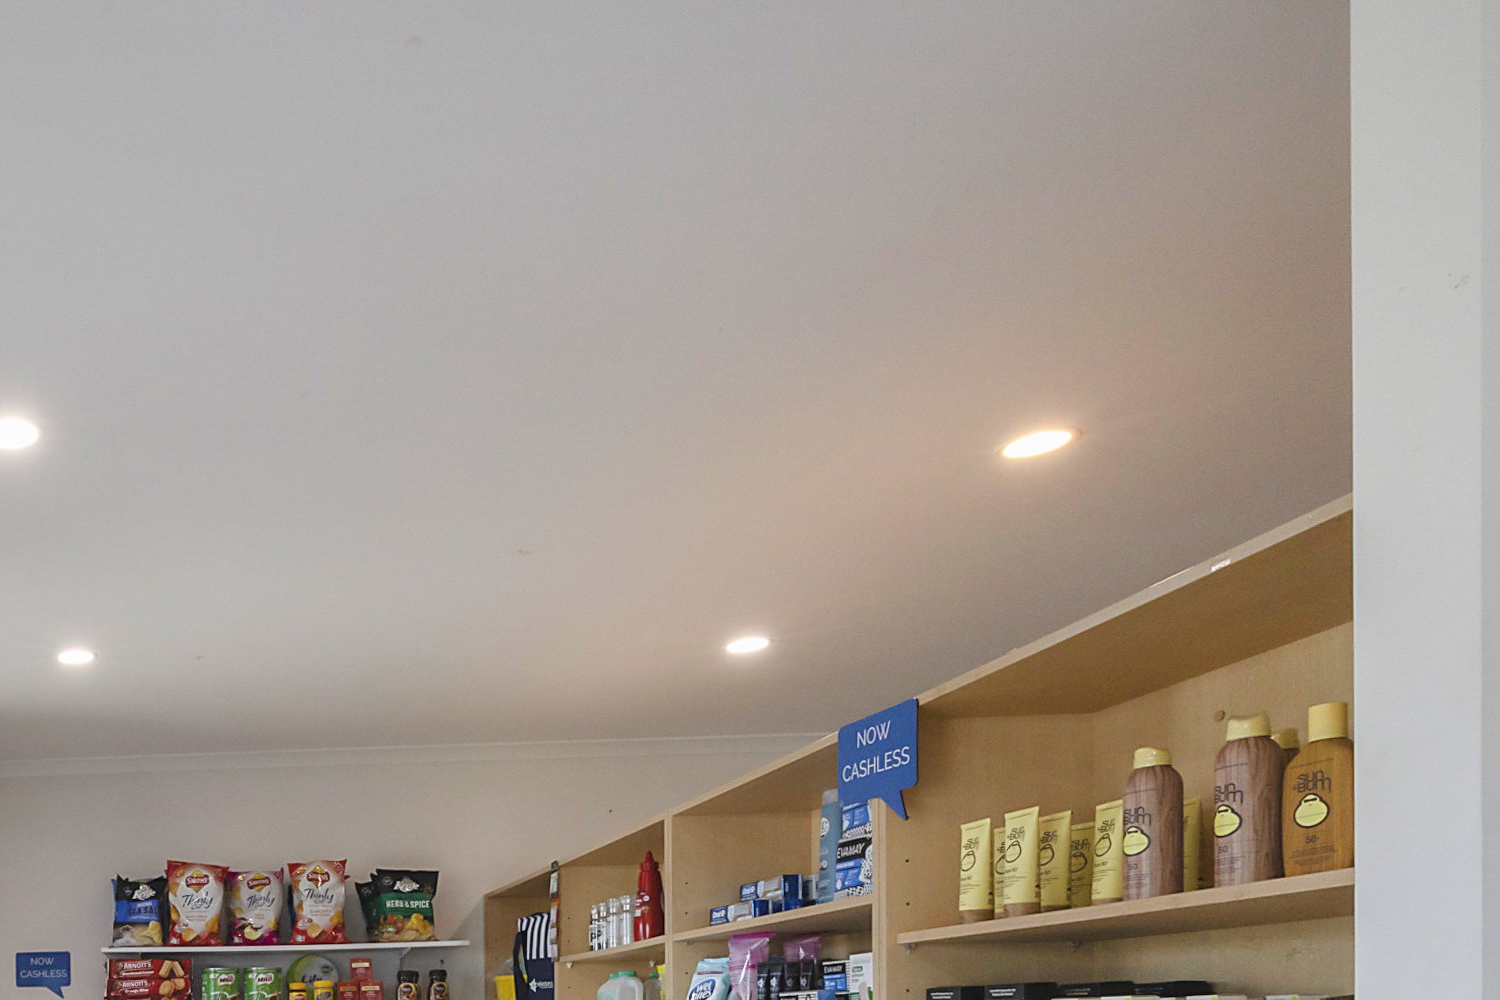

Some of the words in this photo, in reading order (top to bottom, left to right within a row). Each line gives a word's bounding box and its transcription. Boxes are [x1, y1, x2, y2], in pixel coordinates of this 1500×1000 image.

[856, 720, 891, 749] NOW
[842, 746, 911, 783] CASHLESS
[182, 891, 214, 909] Thinly
[247, 891, 275, 909] Thinly
[304, 887, 334, 904] Thinly
[386, 899, 404, 908] HERB
[404, 900, 410, 908] &
[410, 899, 430, 909] SPICE
[30, 957, 54, 966] NOW
[20, 969, 68, 979] CASHLESS
